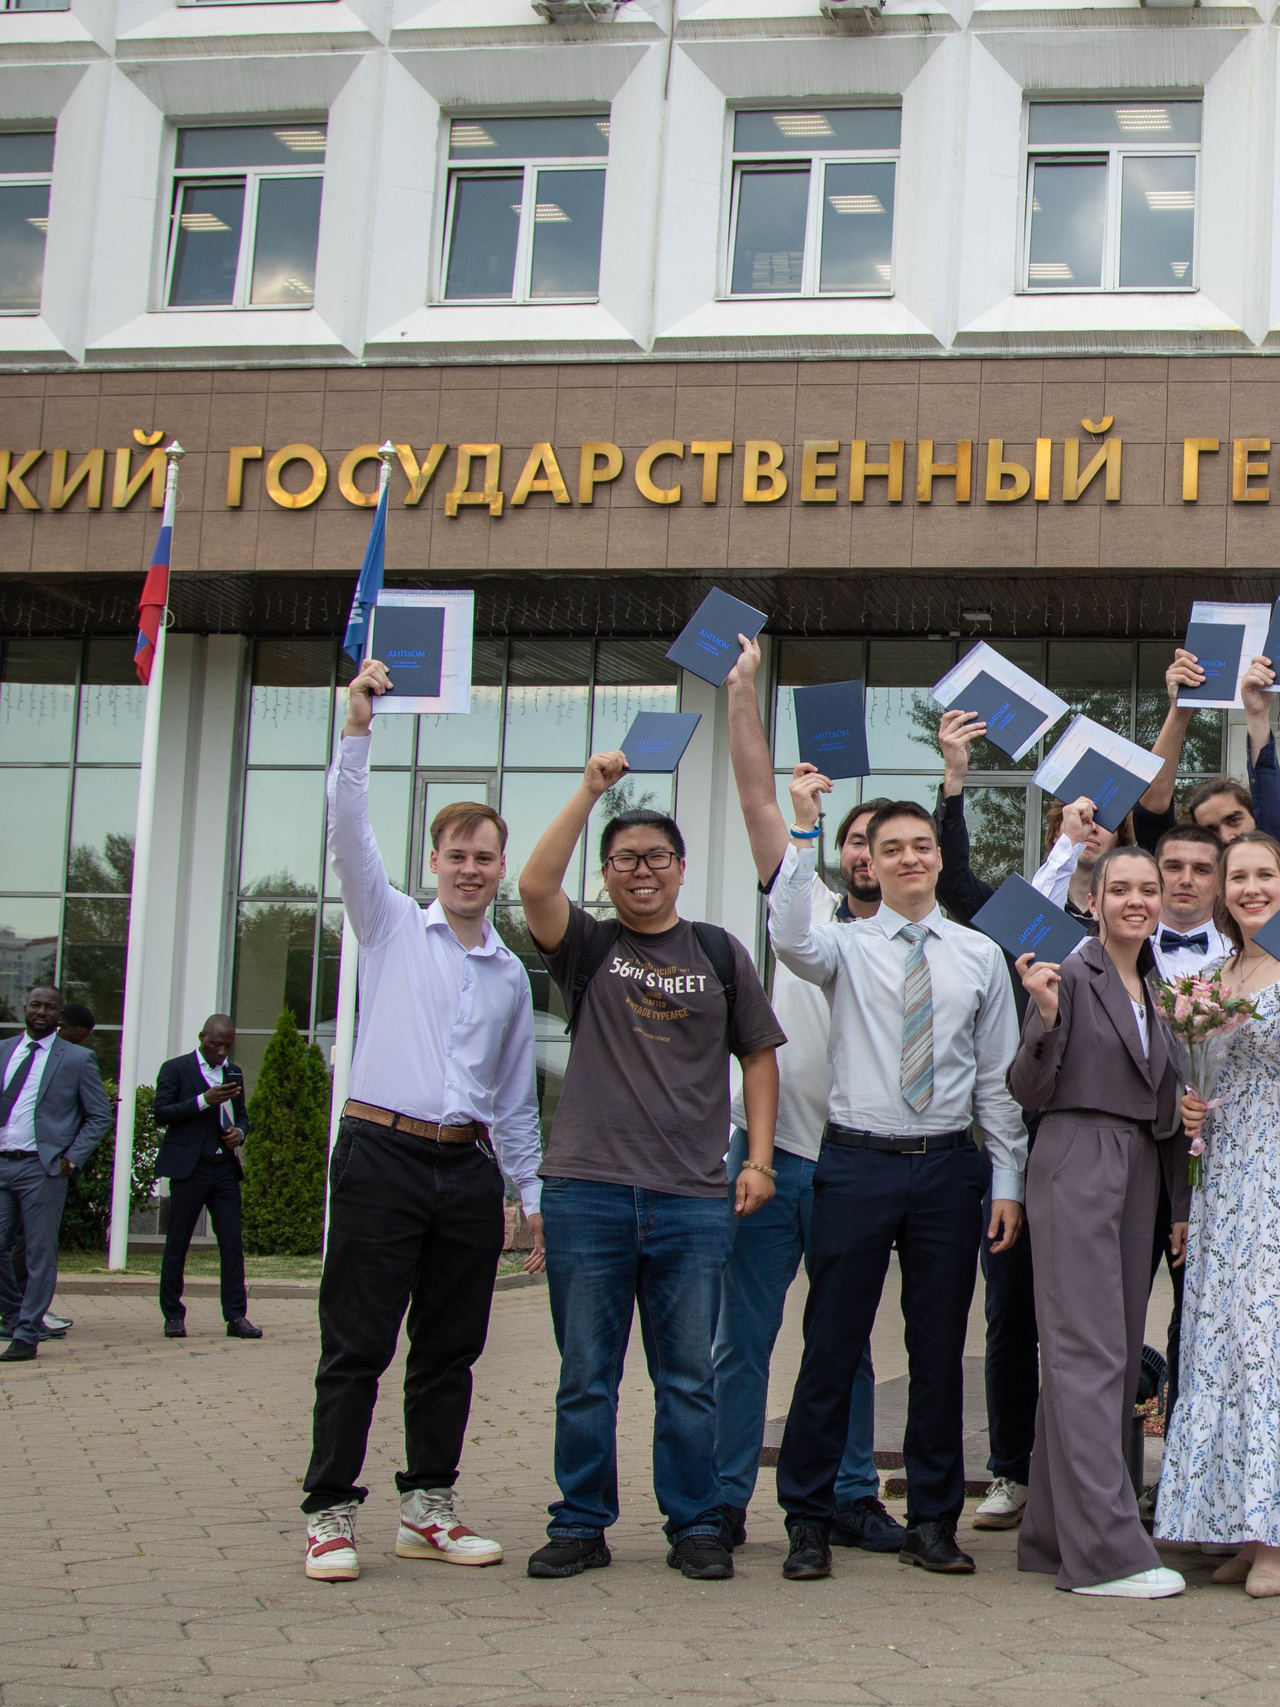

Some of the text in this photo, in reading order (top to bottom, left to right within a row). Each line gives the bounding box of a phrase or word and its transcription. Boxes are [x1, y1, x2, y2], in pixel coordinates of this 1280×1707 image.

[0, 429, 167, 510] КИЙ
[227, 415, 1122, 518] ГОСУДАРСТВЕННЫЙ
[387, 650, 426, 658] ДИПЛОМ
[813, 729, 850, 741] ДИПЛОМ
[1018, 914, 1045, 944] ДИПЛОМ
[645, 972, 706, 994] STREET
